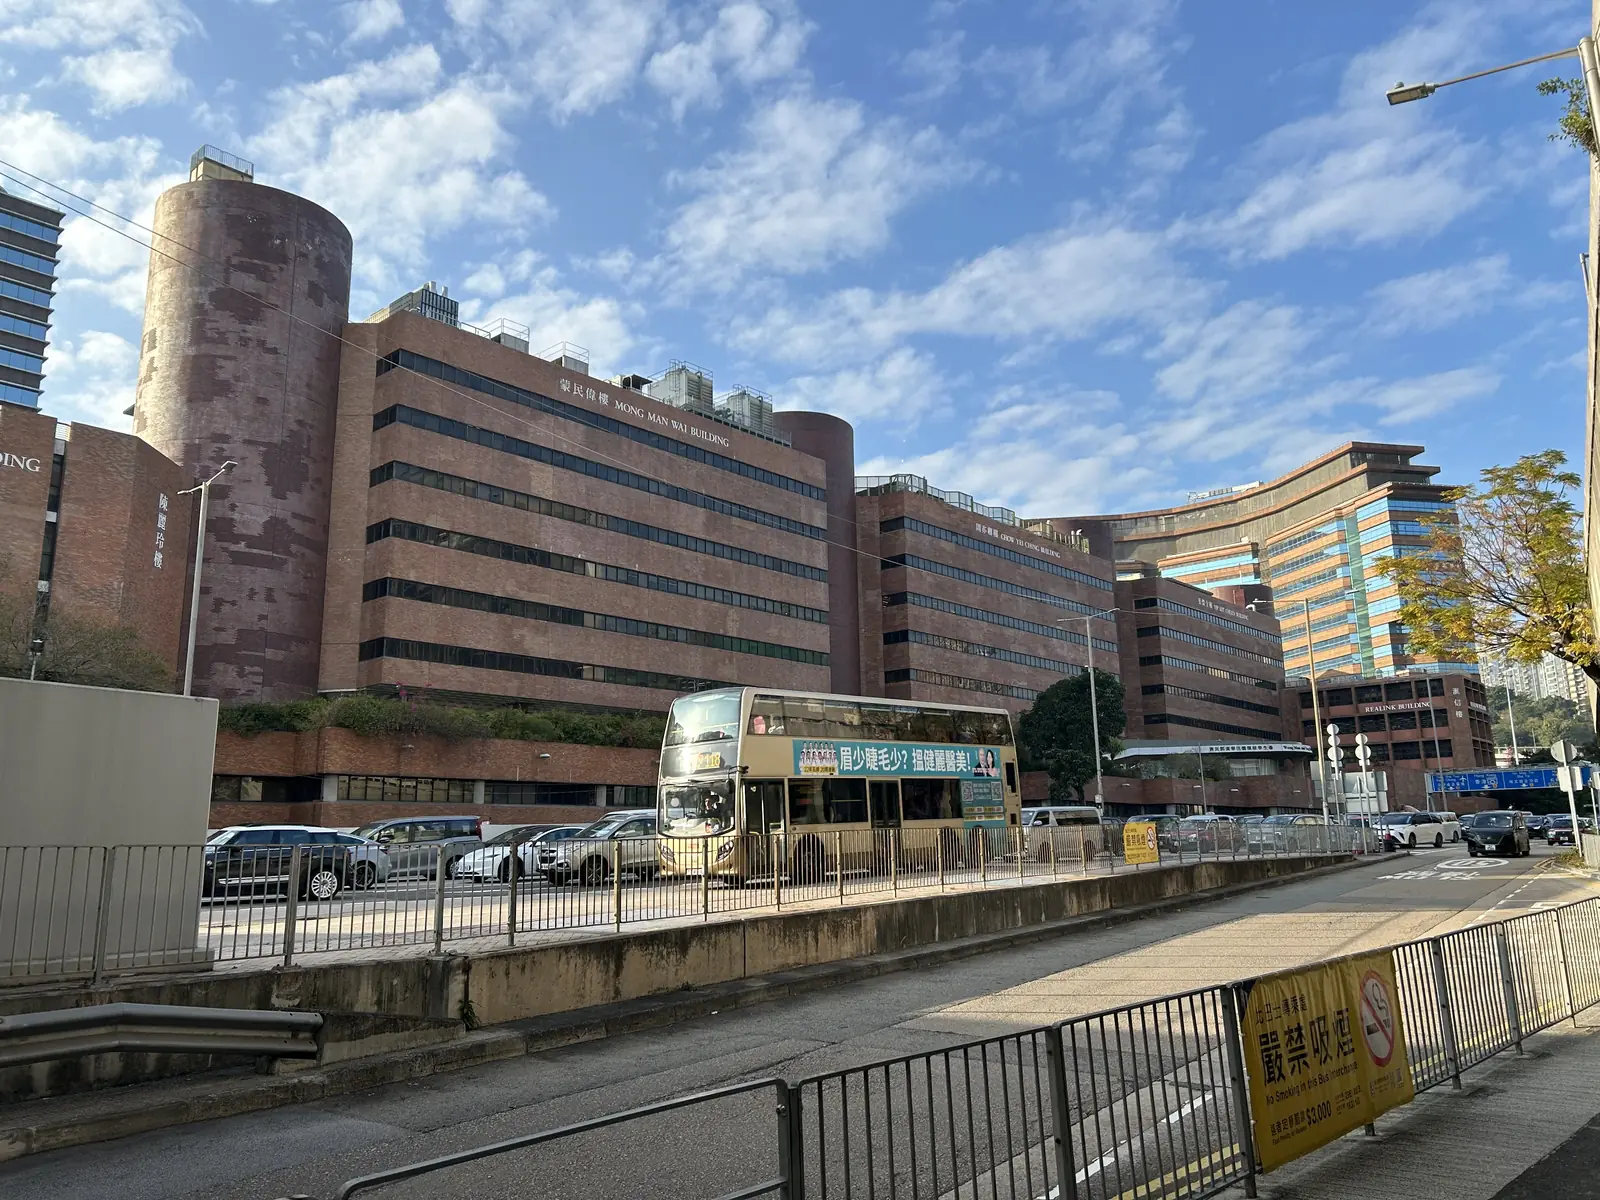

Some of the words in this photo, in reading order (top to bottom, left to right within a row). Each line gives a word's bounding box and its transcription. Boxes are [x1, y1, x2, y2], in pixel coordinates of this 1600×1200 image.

[559, 378, 609, 407] 蒙民偉樓
[614, 400, 645, 418] MONG
[647, 412, 669, 427] MAN
[671, 419, 688, 433] WAI
[690, 426, 730, 447] BUILDING
[1040, 546, 1061, 559] BUILDING
[1365, 704, 1396, 713] REALINK
[1398, 701, 1431, 710] BUILDING
[1259, 1007, 1355, 1087] 嚴禁吸煙
[1265, 1094, 1274, 1106] No
[1276, 1084, 1300, 1103] Smoking
[1300, 1081, 1307, 1092] in
[1307, 1077, 1317, 1089] this
[1318, 1072, 1330, 1085] Bus
[1306, 1100, 1332, 1127] $3,000
